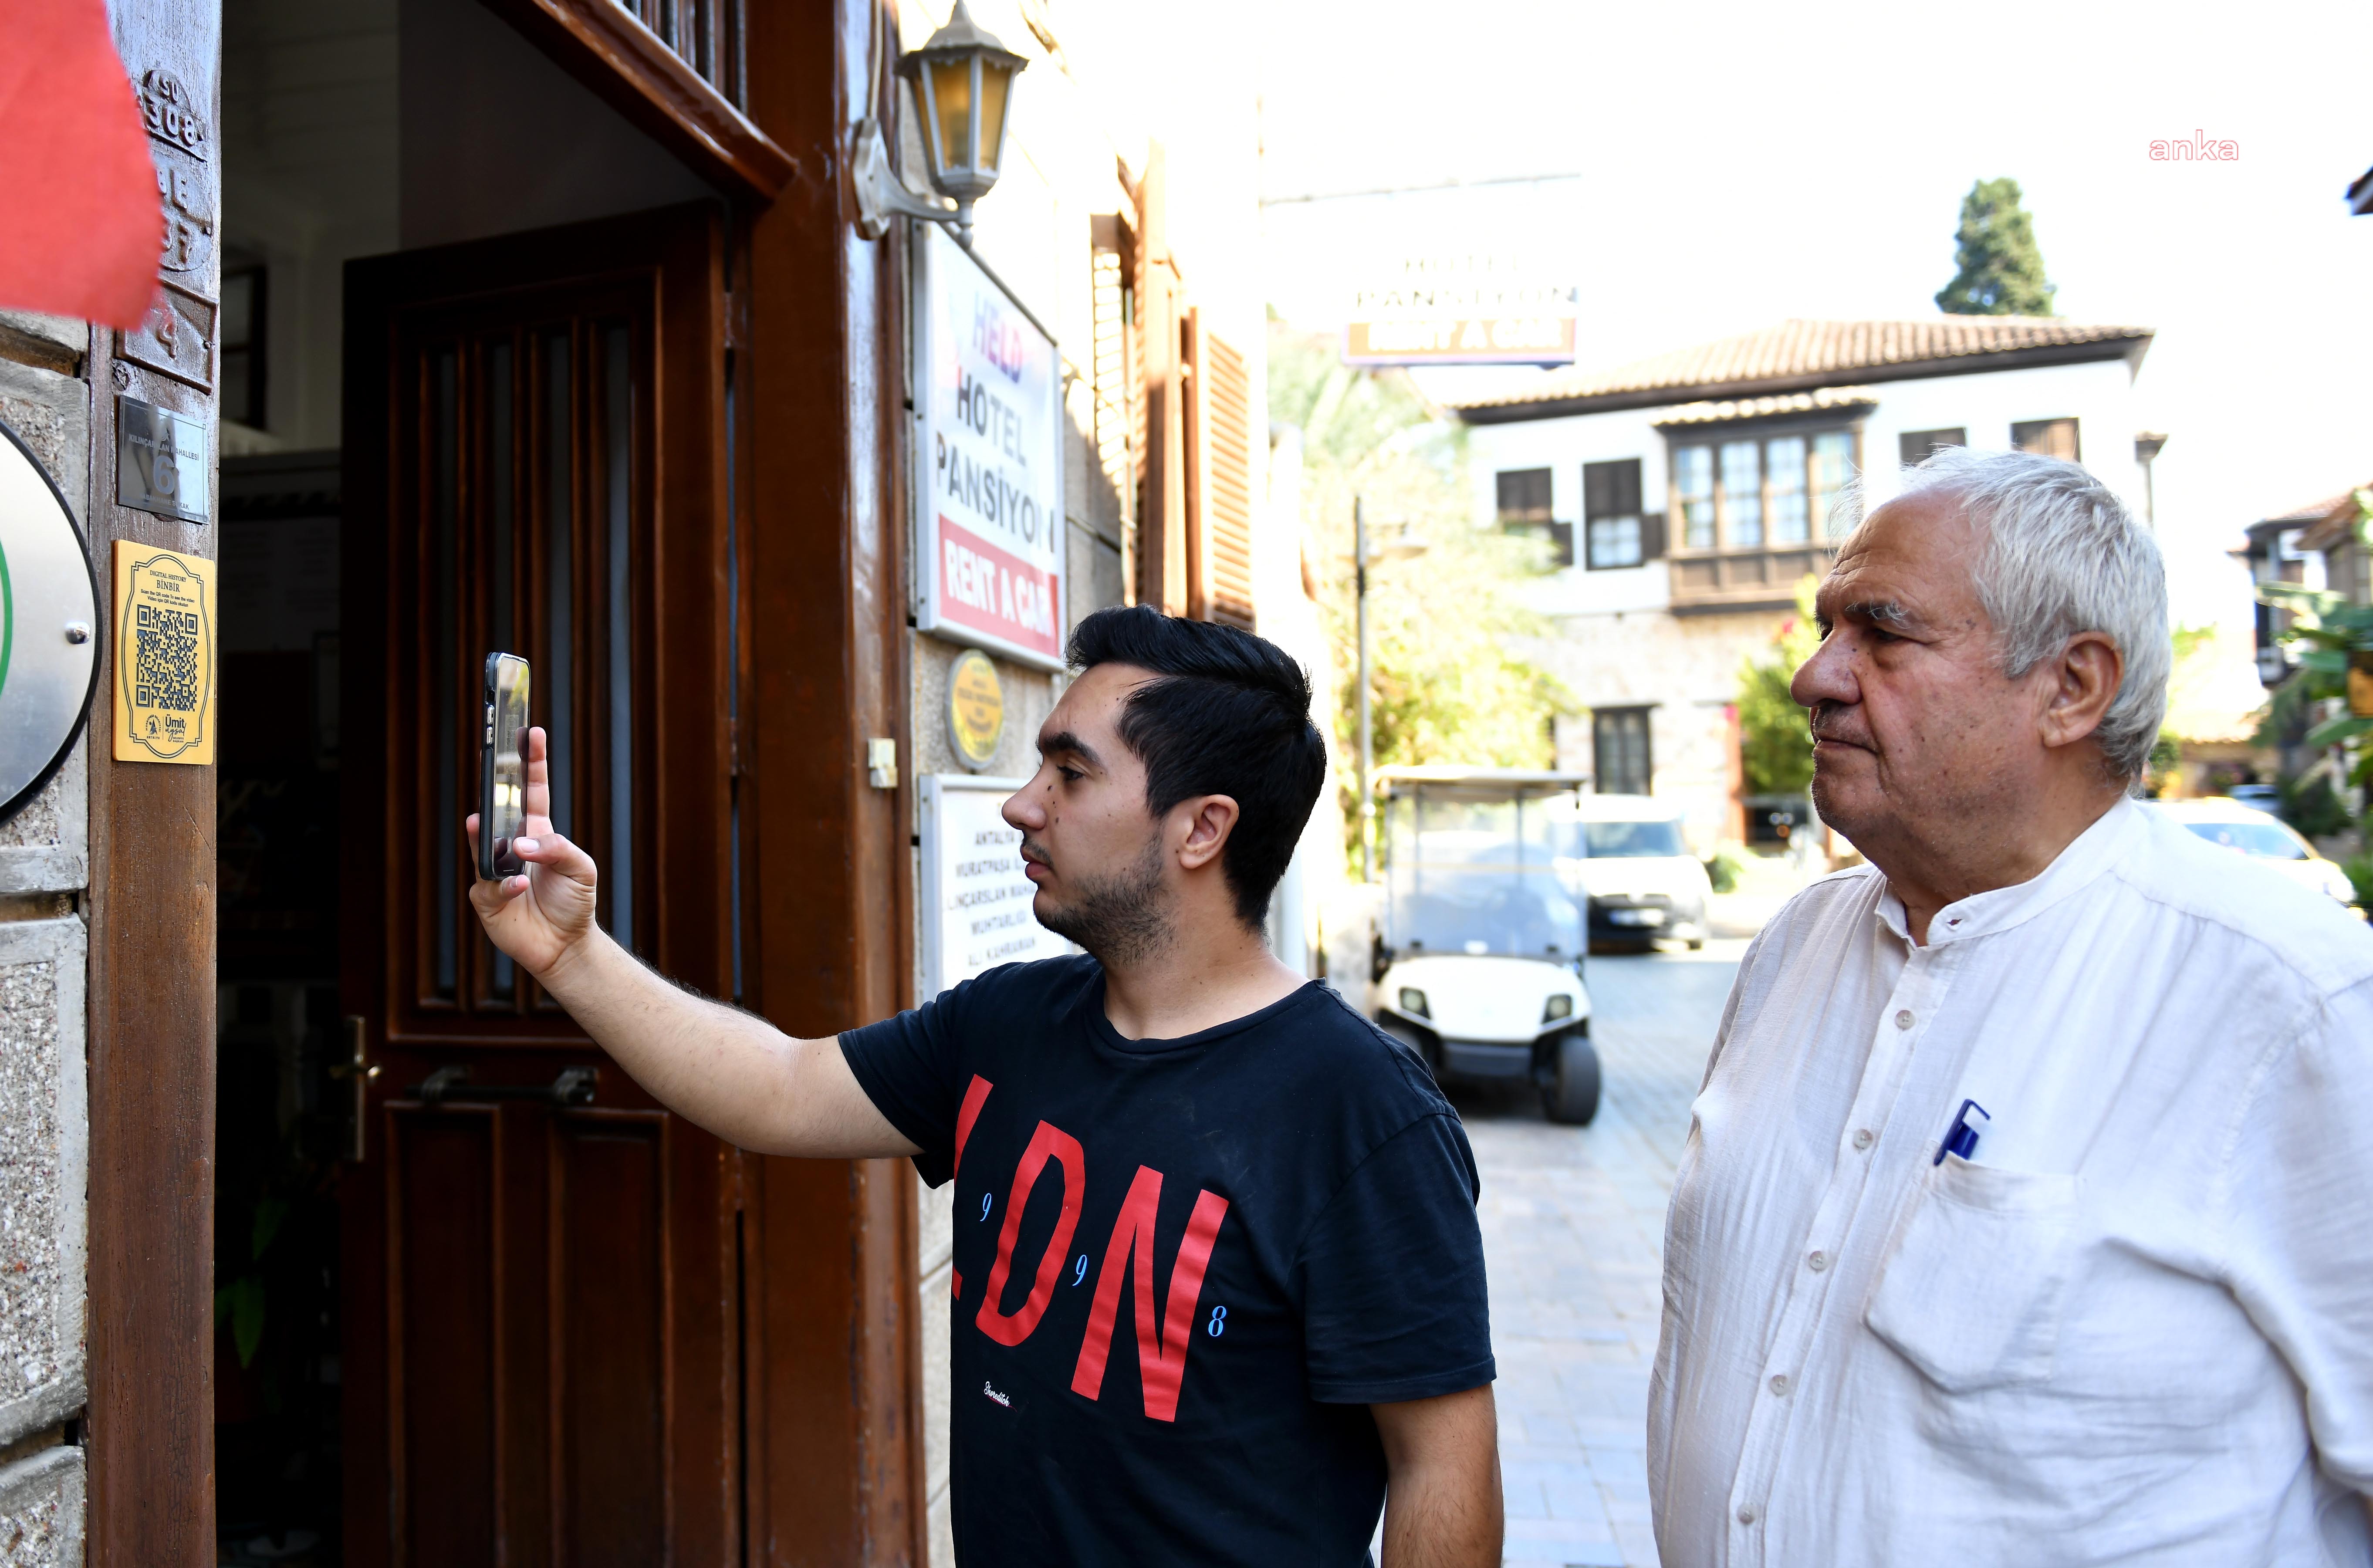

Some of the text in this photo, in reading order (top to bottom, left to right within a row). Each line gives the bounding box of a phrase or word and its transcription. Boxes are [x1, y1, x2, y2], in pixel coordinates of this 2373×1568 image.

[137, 92, 195, 148] 308
[957, 365, 1027, 468] HOTEL
[153, 455, 175, 495] 6
[150, 570, 186, 582] DIGITAL HISTORY
[157, 579, 180, 592] BİNBİR
[945, 538, 1053, 639] RENT A CAR
[166, 714, 185, 728] Ümit
[975, 830, 1014, 846] ANTALYA
[944, 887, 1005, 911] LINÇARSLAN
[980, 1193, 1227, 1336] 9 9 8
[984, 1381, 1010, 1407] Shoreditch
